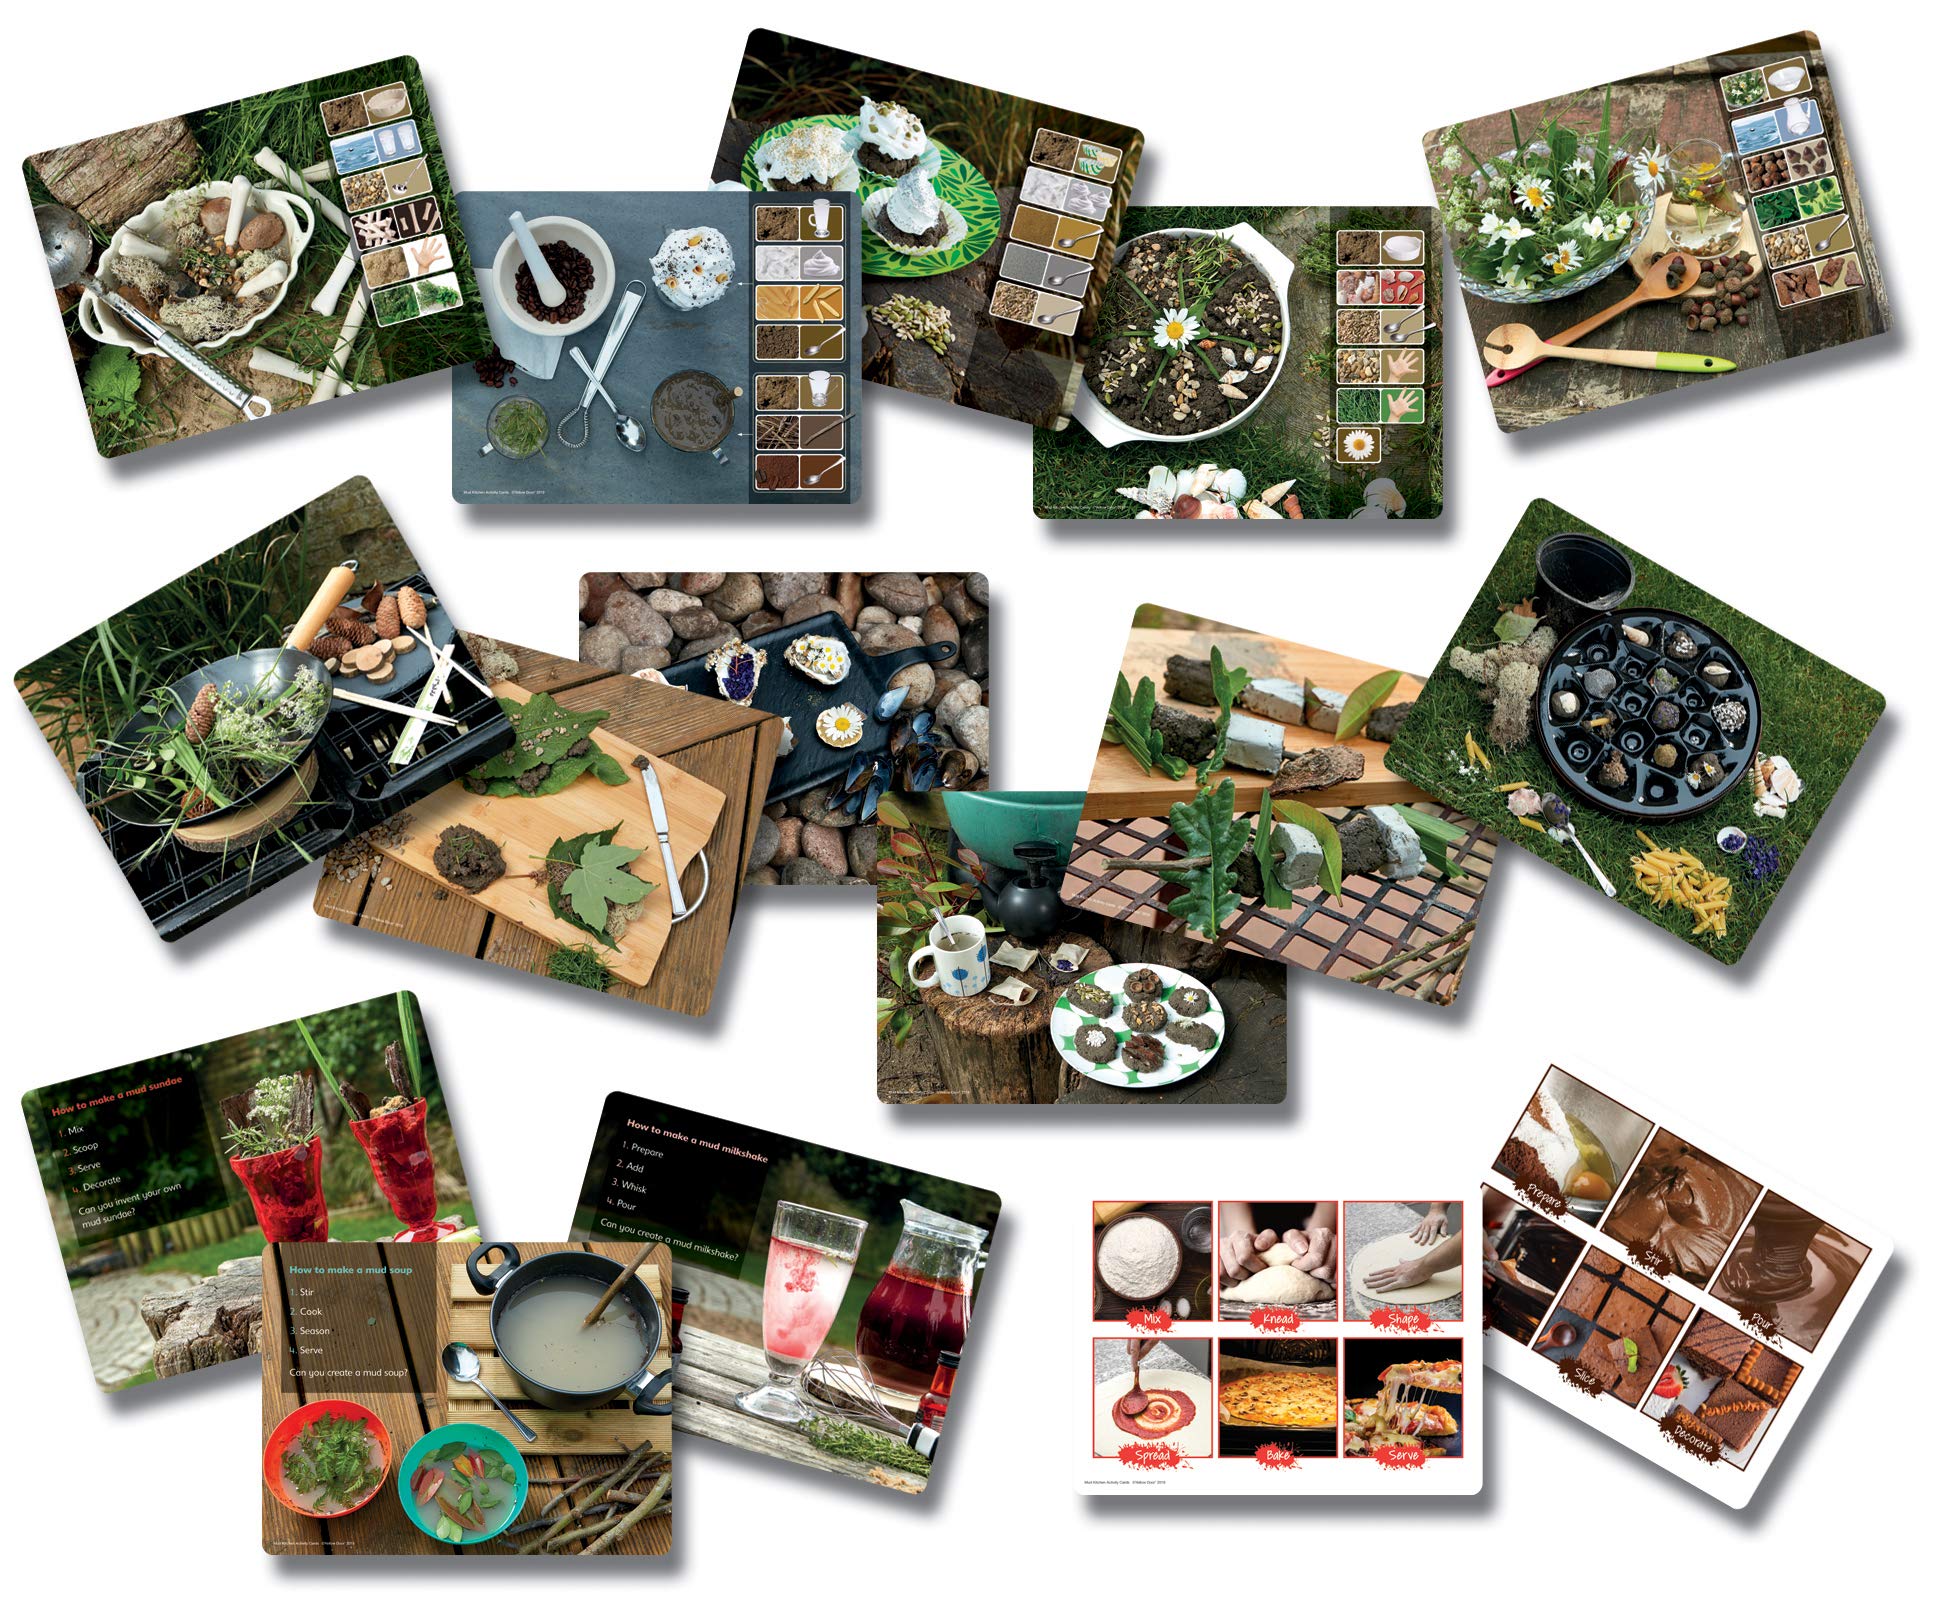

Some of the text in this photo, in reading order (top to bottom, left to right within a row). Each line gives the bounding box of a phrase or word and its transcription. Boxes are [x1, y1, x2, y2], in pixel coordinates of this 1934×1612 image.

[51, 1105, 74, 1117] How
[76, 1102, 87, 1110] to
[89, 1093, 115, 1108] make
[125, 1084, 147, 1097] mud
[148, 1076, 183, 1091] sundae
[58, 1125, 84, 1138] 1. Mix
[626, 1118, 650, 1131] How
[651, 1125, 661, 1135] to
[662, 1129, 689, 1142] make
[699, 1139, 721, 1151] mud
[721, 1145, 769, 1163] milkshake
[63, 1142, 99, 1157] 2. Scoop
[622, 1140, 664, 1159] 1. Prepare
[68, 1160, 101, 1176] 3. Serve
[616, 1159, 644, 1173] 2. Add
[82, 1175, 121, 1192] Decorate
[611, 1177, 648, 1194] 3. Whisk
[78, 1183, 182, 1216] Can you invent your own
[606, 1197, 637, 1211] 4. Pour
[1527, 1183, 1562, 1209] Prepare
[82, 1207, 136, 1229] mud sundae?
[600, 1217, 739, 1262] Can you create a mud milkshake?
[1644, 1251, 1663, 1267] Stir
[289, 1266, 312, 1274] How
[314, 1266, 325, 1274] to
[327, 1265, 354, 1274] make
[365, 1265, 387, 1274] mud
[389, 1267, 413, 1276] soup
[300, 1288, 314, 1296] Stir
[290, 1307, 323, 1316] 2. Cook
[1144, 1312, 1161, 1325] Mix
[1263, 1312, 1294, 1325] Knead
[1388, 1312, 1419, 1330] Shape
[1751, 1312, 1773, 1329] Pour
[289, 1327, 330, 1335] 3. Season
[289, 1346, 324, 1354] 4. Serve
[289, 1368, 307, 1377] Can
[308, 1370, 325, 1379] you
[327, 1369, 353, 1377] create
[363, 1368, 382, 1377] mud
[384, 1368, 408, 1379] soup?
[1575, 1368, 1596, 1385] Slice
[1674, 1424, 1713, 1453] Decorate
[1135, 1448, 1171, 1466] Spread
[1266, 1449, 1290, 1461] Bake
[1389, 1449, 1420, 1461] Serve
